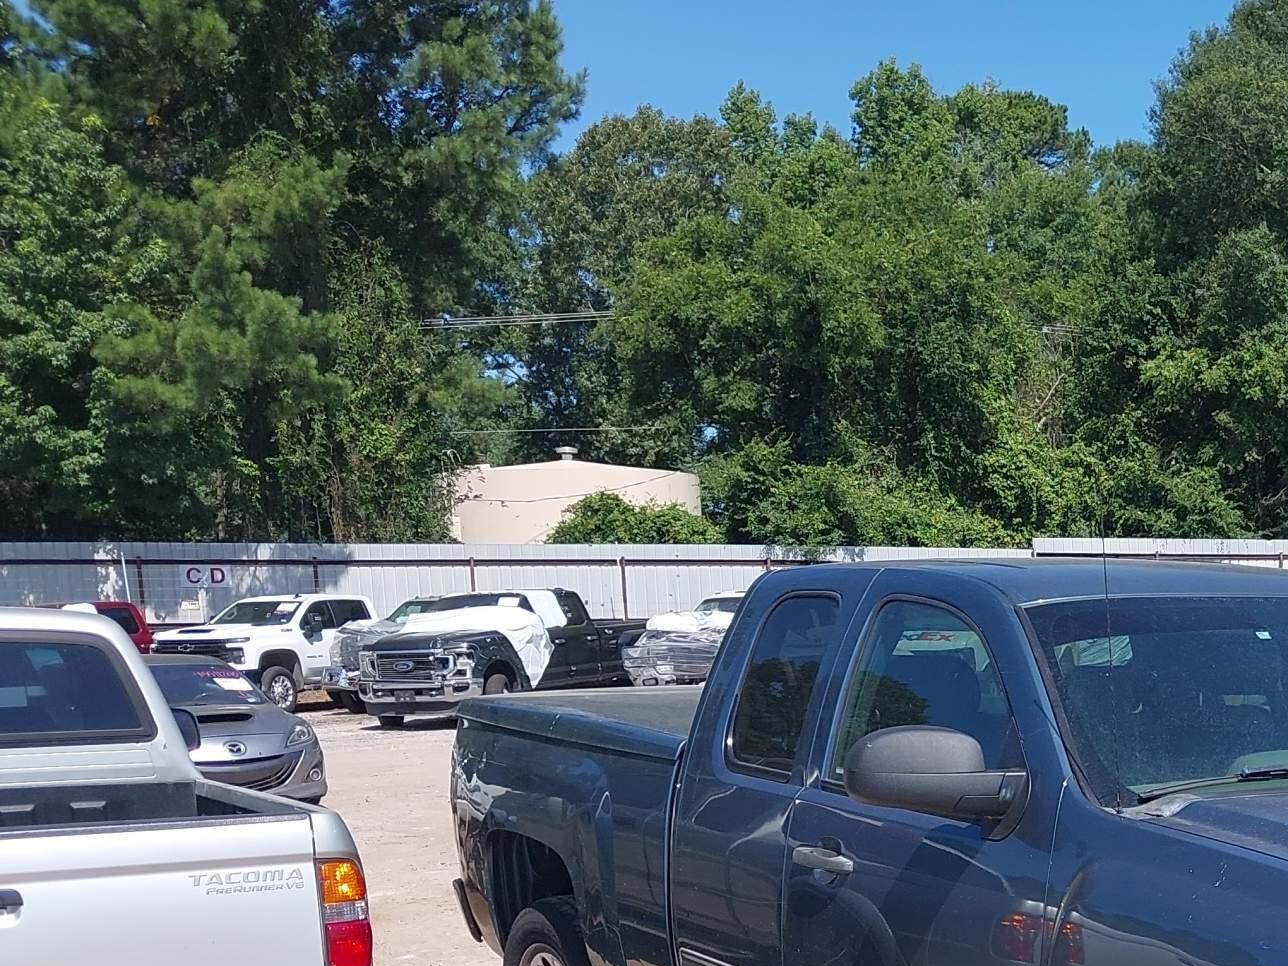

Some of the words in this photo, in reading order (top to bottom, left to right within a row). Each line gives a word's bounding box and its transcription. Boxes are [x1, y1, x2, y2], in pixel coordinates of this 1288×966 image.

[186, 567, 202, 584] C
[209, 567, 226, 584] D
[188, 867, 304, 887] TACOMA
